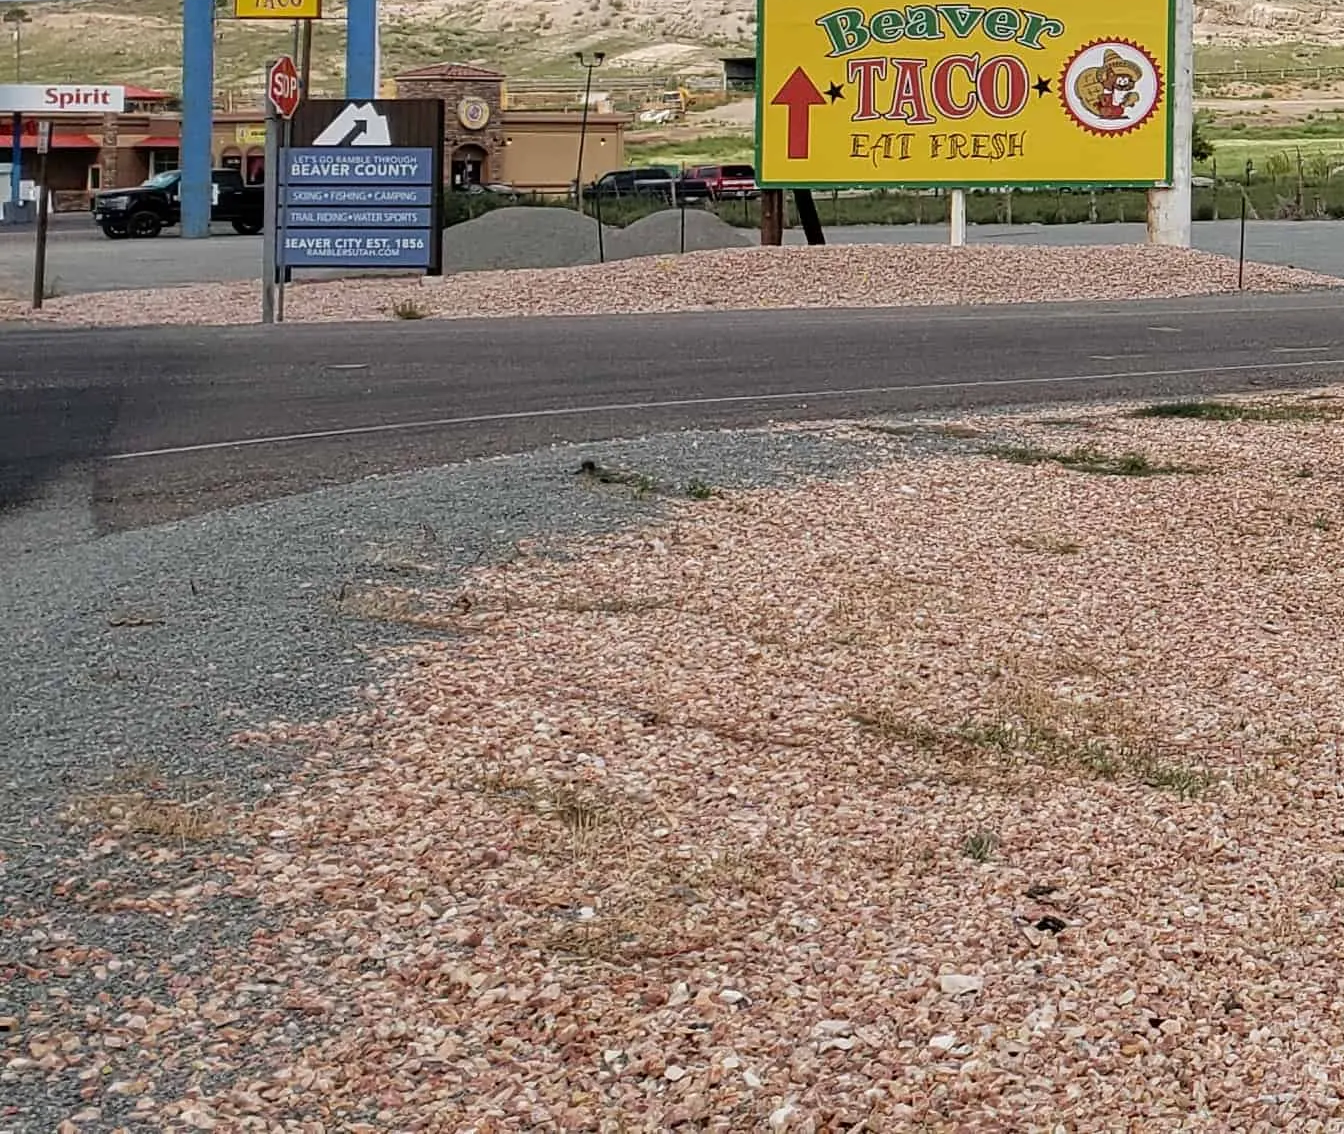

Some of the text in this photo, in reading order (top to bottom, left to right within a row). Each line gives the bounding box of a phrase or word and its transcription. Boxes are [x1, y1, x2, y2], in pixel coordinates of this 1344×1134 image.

[816, 4, 1065, 58] Beaver
[847, 52, 1030, 125] TACO
[45, 88, 110, 109] Spirit
[849, 130, 1028, 168] EAT FRESH
[294, 154, 417, 164] LET'S GO RAMBLE THROUGH
[291, 164, 418, 176] BEAVER COUNTY
[330, 191, 366, 201] FISHING
[374, 191, 417, 201] CAMPING
[291, 212, 418, 222] TRAIL RIDING WATER SPORTS
[335, 238, 362, 249] CITY
[366, 238, 390, 248] EST.
[395, 238, 424, 248] 1856
[306, 248, 400, 257] RAMBLERSUTAH.COM
